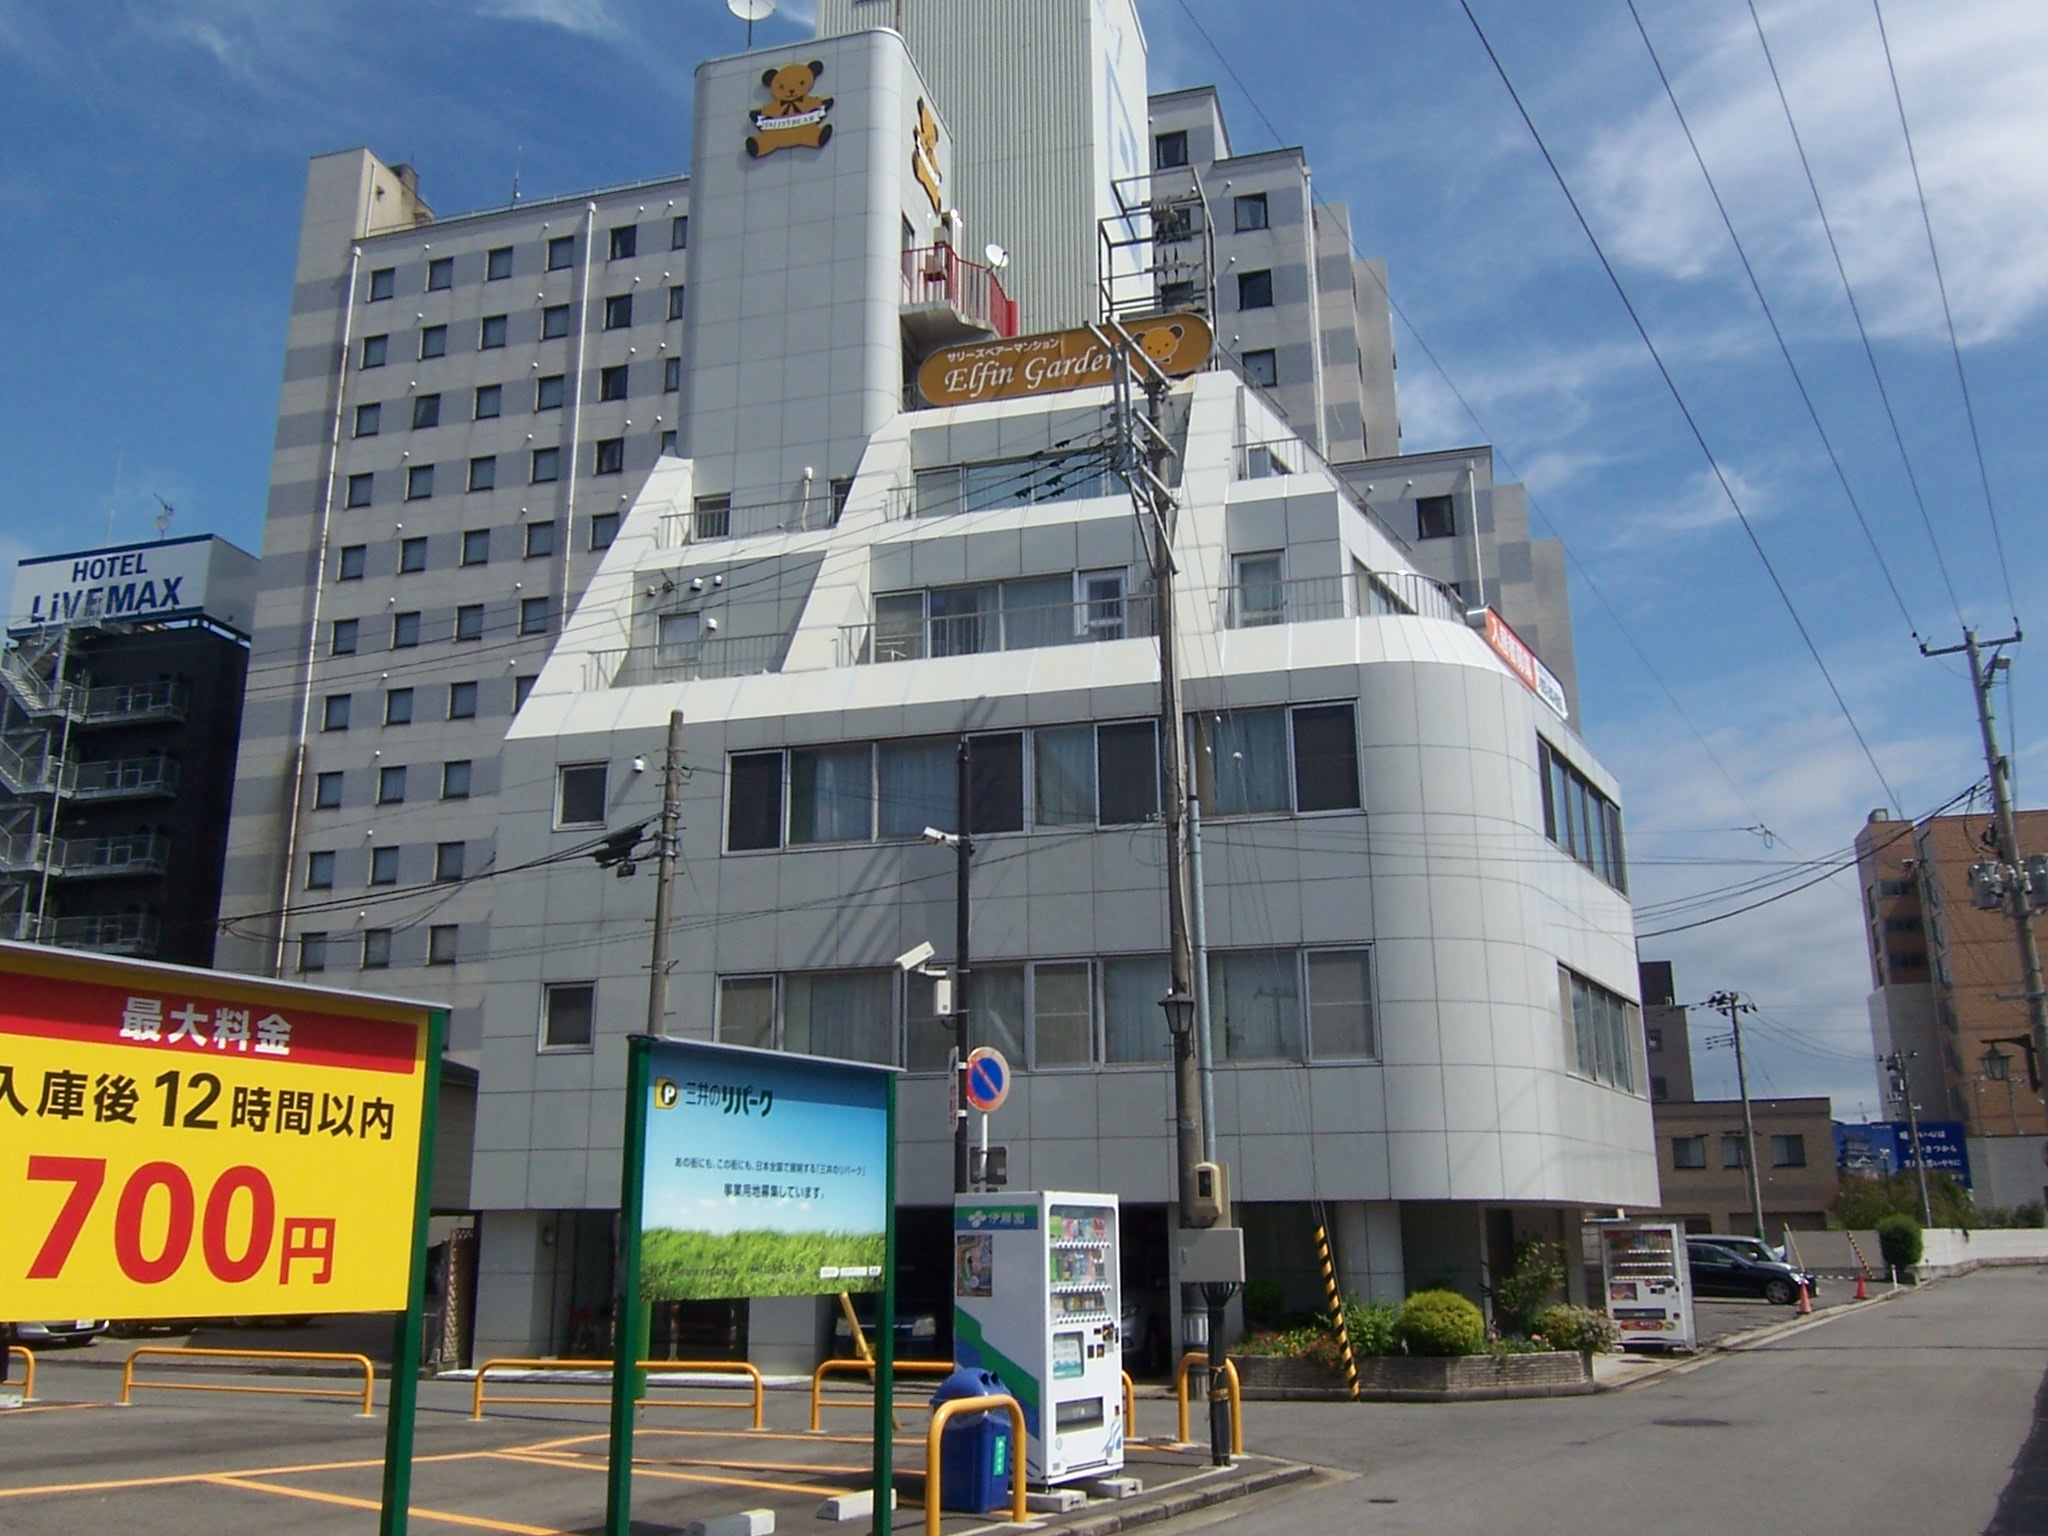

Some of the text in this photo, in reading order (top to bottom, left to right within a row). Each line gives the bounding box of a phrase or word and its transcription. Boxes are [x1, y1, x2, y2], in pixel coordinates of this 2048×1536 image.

[944, 358, 1015, 398] Elfin
[72, 552, 148, 583] HOTEL
[119, 996, 293, 1055] 最大料金
[685, 1081, 774, 1118] 三井のリパーク
[25, 1154, 337, 1286] 700円
